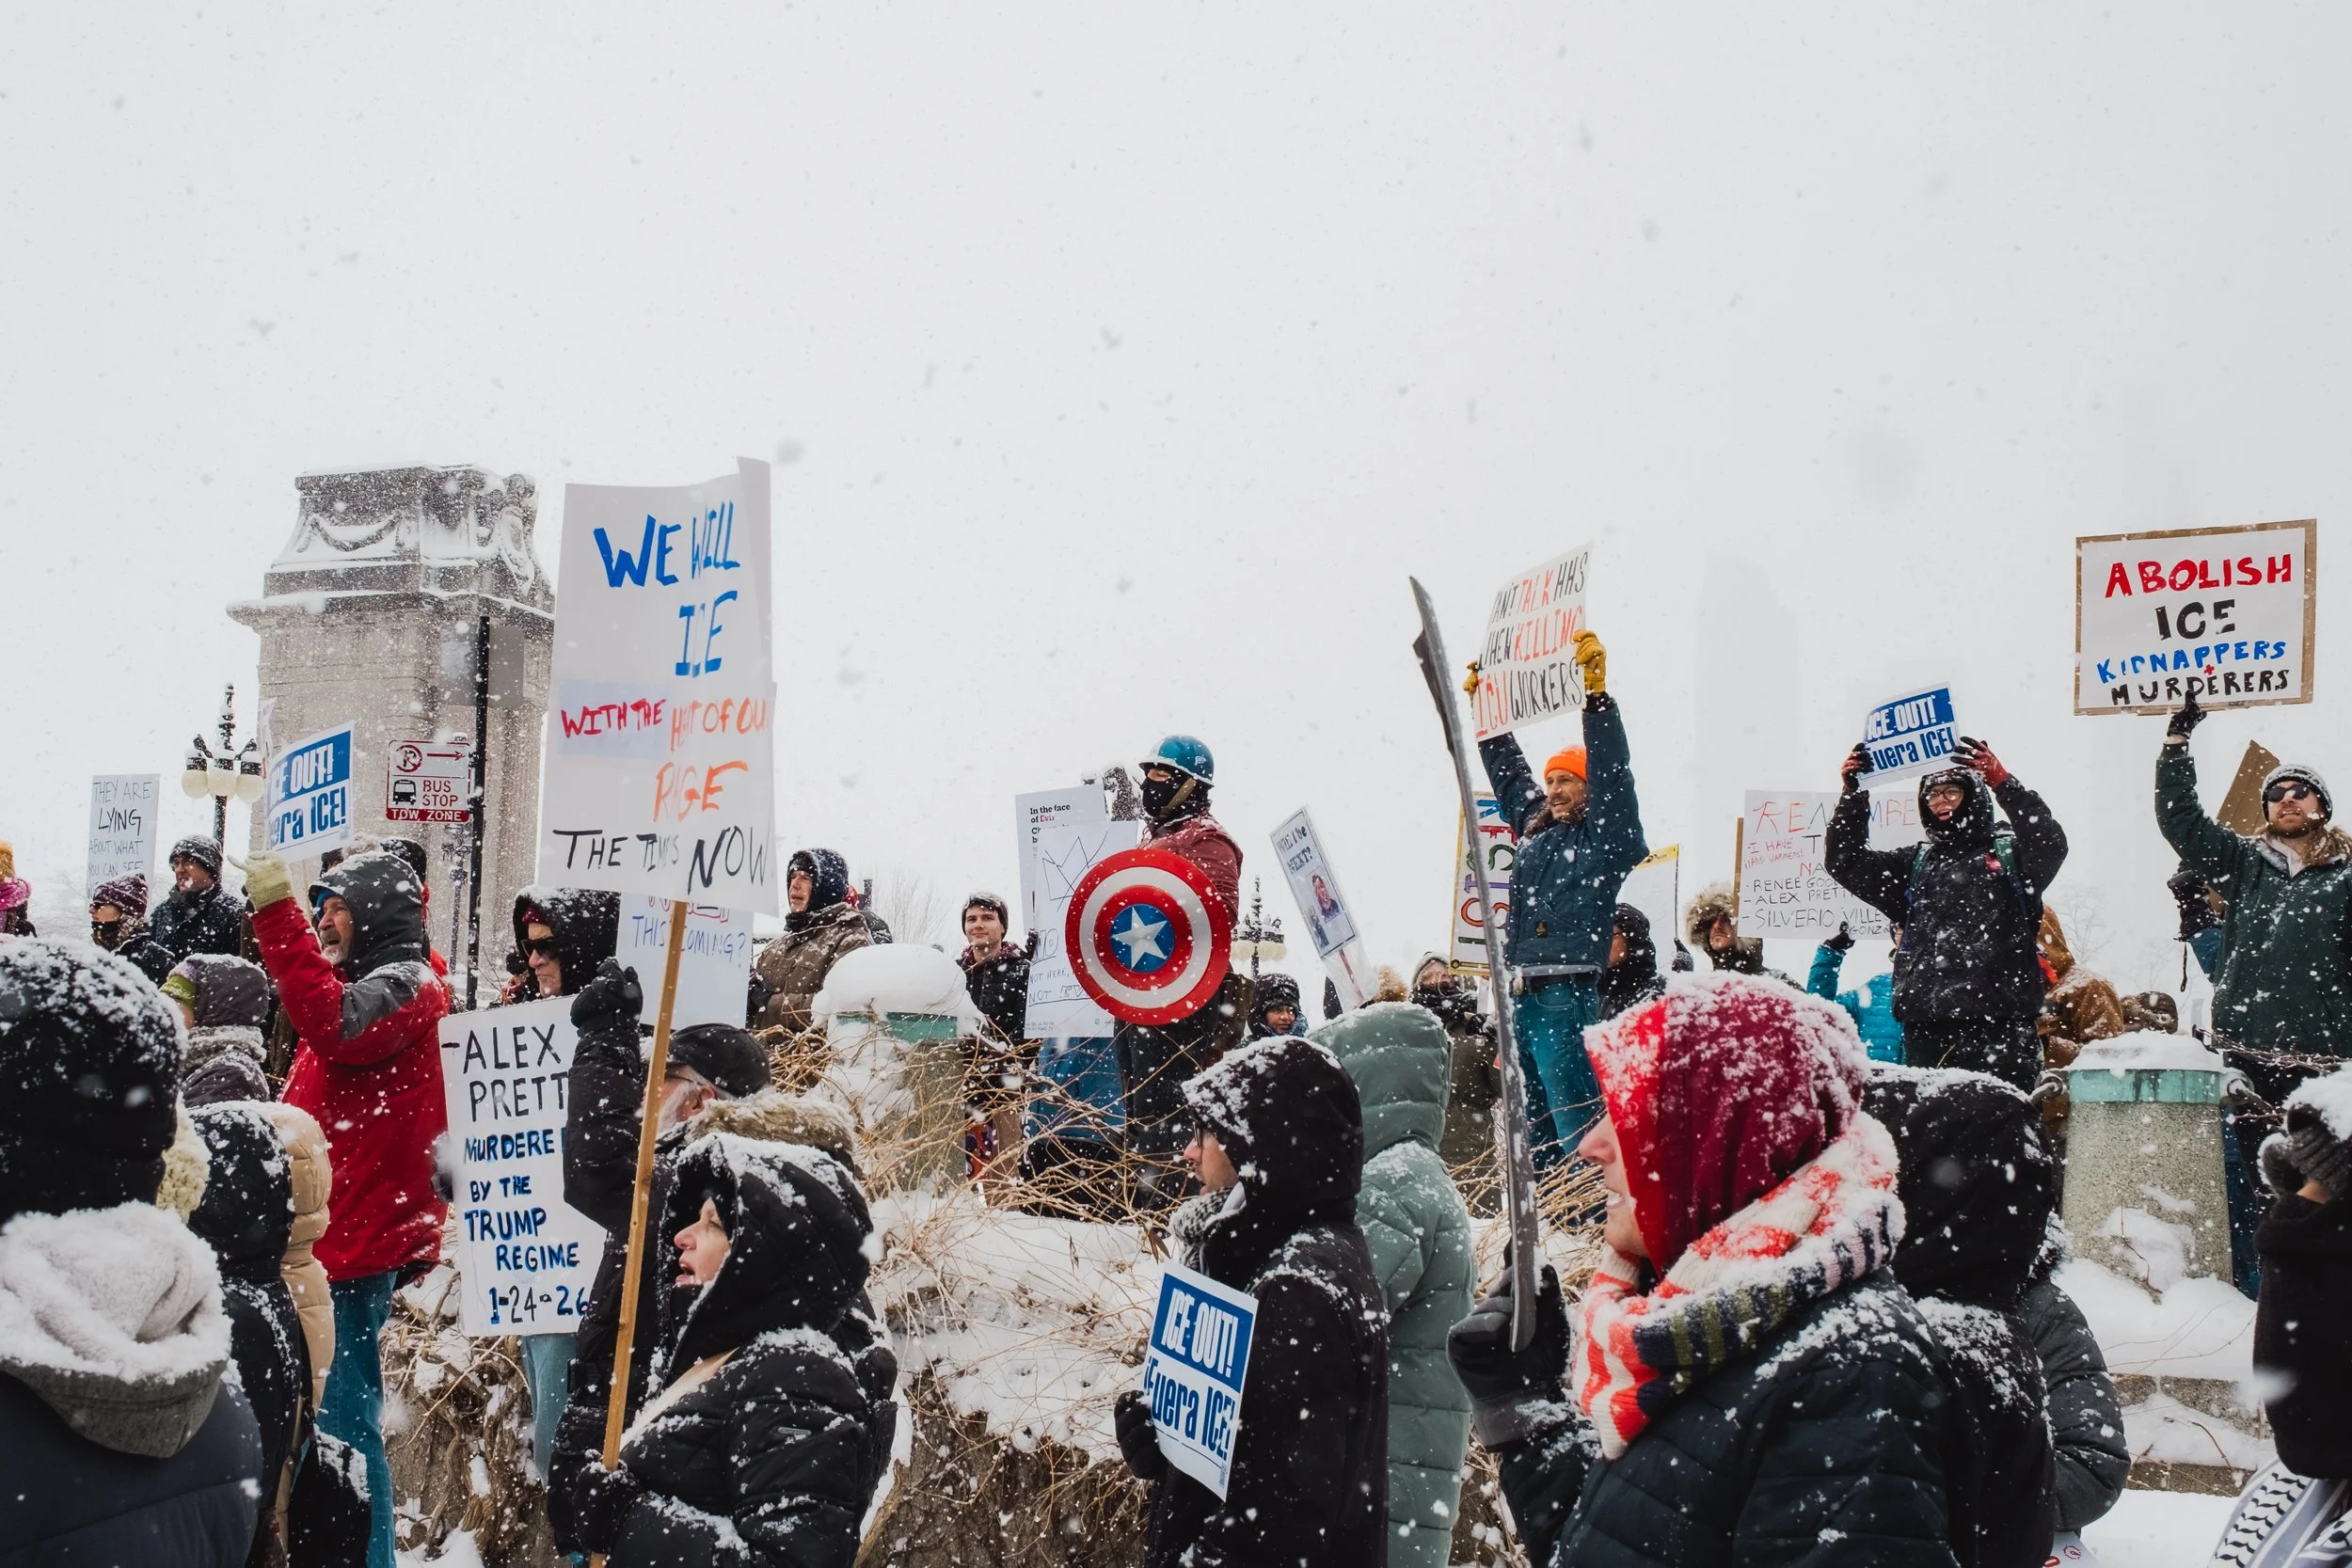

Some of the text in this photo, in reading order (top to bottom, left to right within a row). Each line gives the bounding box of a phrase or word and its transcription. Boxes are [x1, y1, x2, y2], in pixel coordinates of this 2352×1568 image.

[594, 499, 740, 588] WE WILL
[1517, 569, 1553, 616] TALK
[1553, 551, 1588, 602] HHS
[2105, 553, 2292, 598] ABOLISH
[2154, 599, 2236, 641] ICE
[2096, 641, 2287, 684] KIDNAPPERS
[1475, 656, 1582, 737] ICU WORKERS
[2110, 669, 2290, 705] MURDERERS
[561, 697, 770, 753] WITH THE HT OF OU
[1893, 696, 1937, 733] OUT!
[290, 742, 333, 794] OUT!
[93, 779, 152, 803] THEY ARE
[422, 780, 452, 793] BUS
[422, 794, 458, 807] STOP
[98, 807, 141, 836] LYING
[310, 786, 346, 834] ICE!
[391, 810, 462, 821] TOW ZONE
[1753, 799, 1916, 835] REMMBE
[89, 838, 144, 855] ABOUT WHAT
[552, 829, 629, 870] THE
[1765, 837, 1794, 852] HAVE
[103, 862, 119, 878] CAN
[1754, 877, 1802, 893] RENEE
[1756, 891, 1802, 905] ALEX
[1755, 908, 1836, 929] SILVERIO
[1028, 990, 1053, 1005] NOT
[470, 1175, 532, 1203] BY THE
[464, 1207, 547, 1243] TRUMP
[495, 1242, 580, 1273] REGIME
[1161, 1288, 1240, 1379] ICE OUT!
[1200, 1385, 1235, 1462] ICE!
